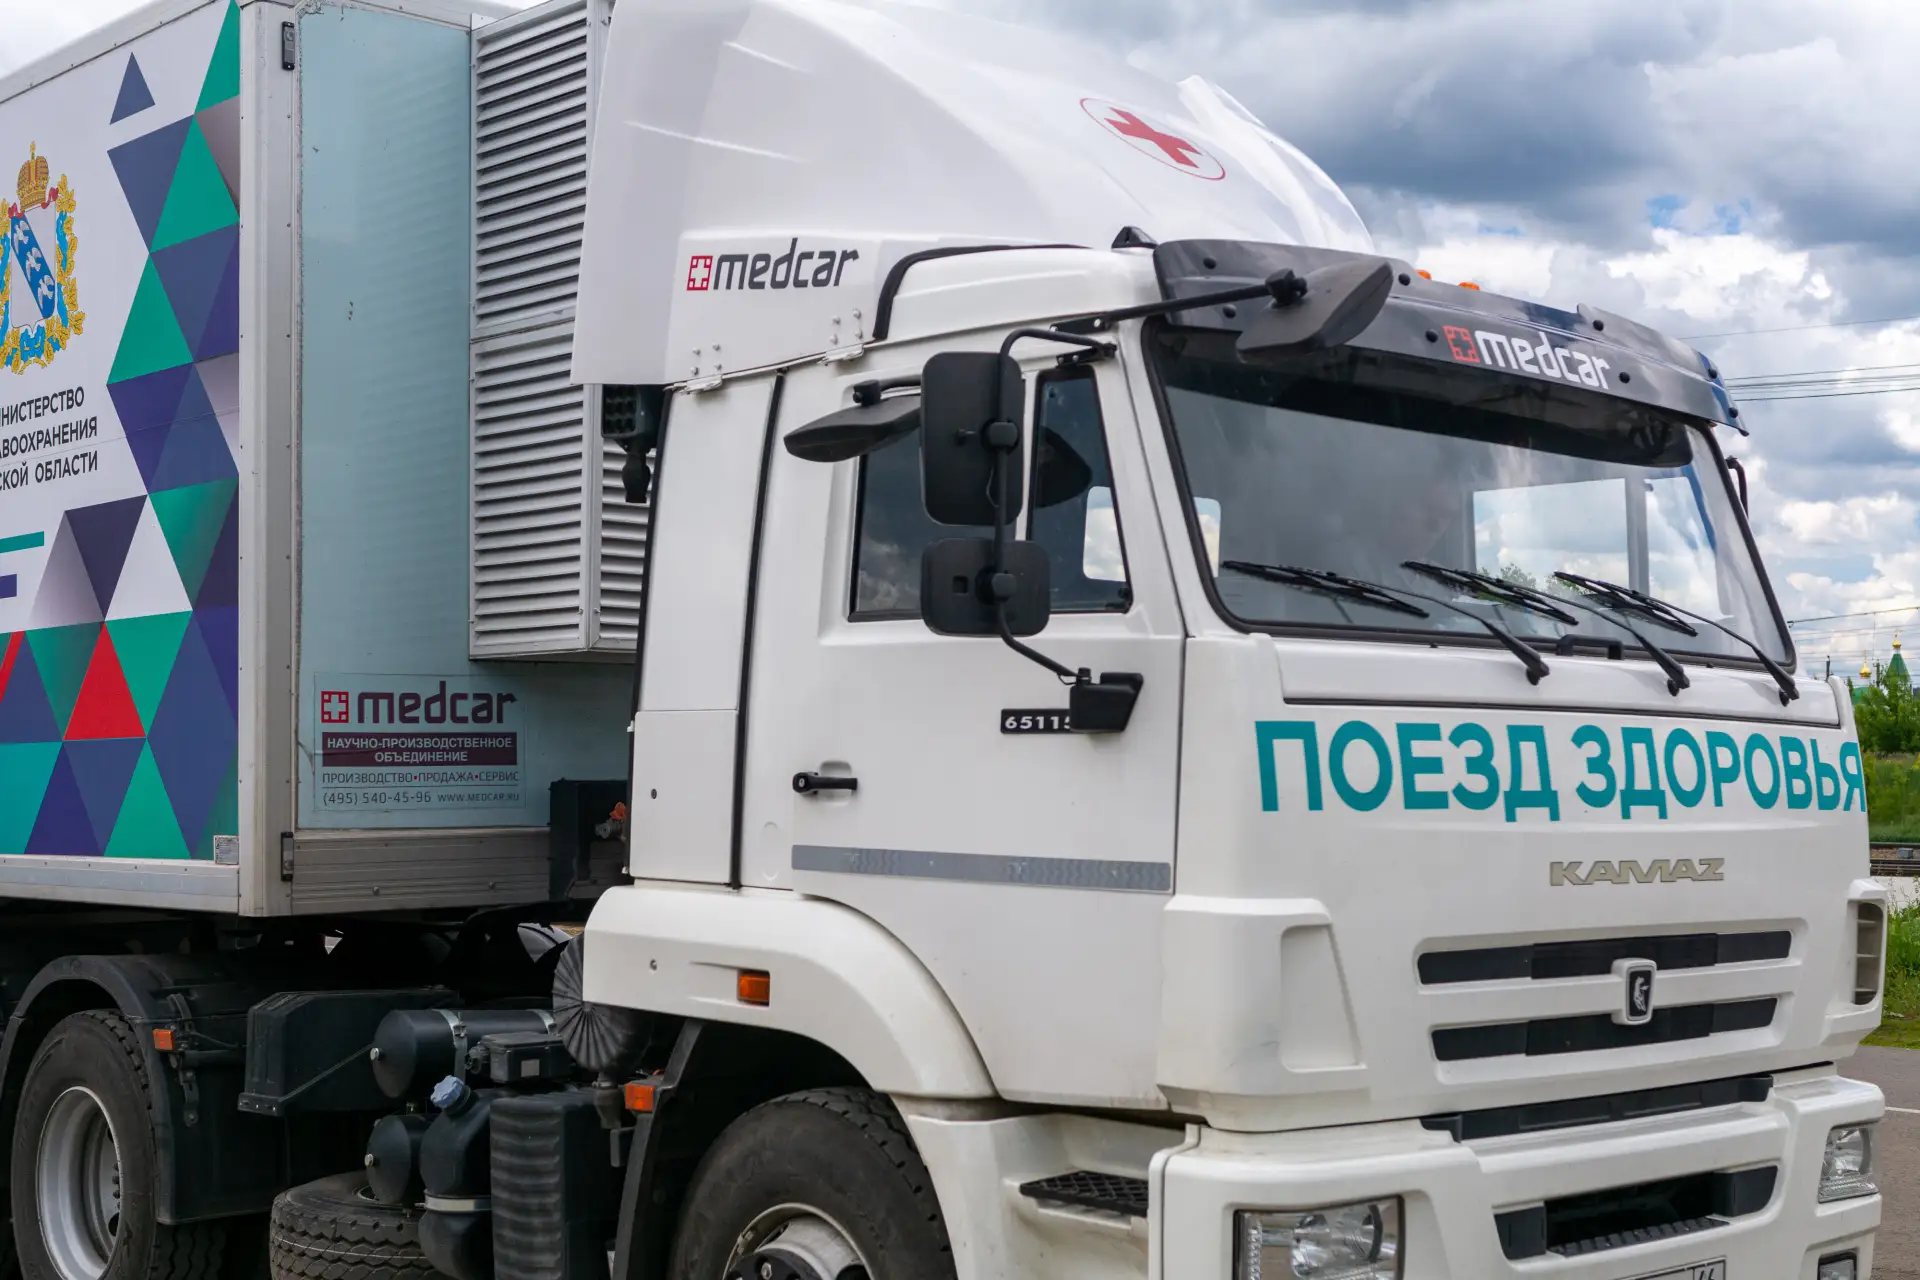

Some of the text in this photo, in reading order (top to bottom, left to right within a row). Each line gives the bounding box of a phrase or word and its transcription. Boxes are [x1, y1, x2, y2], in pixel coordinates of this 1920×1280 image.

[713, 237, 860, 290] medcar
[1474, 330, 1612, 389] medcar
[0, 386, 84, 427] НИСТЕРСТВО
[0, 416, 97, 458] ВООХРАНЕНИЯ
[35, 450, 98, 483] ОБЛАСТИ
[357, 680, 518, 724] medcar
[327, 737, 513, 749] НАУЧНО-ПРОИЗВОДСТВЕННОЕ
[374, 751, 468, 763] ОБЪЕДИНЕНИЕ
[1255, 720, 1866, 822] ПОЕЗД ЗДОРОВЬЯ
[323, 792, 358, 806] (495)
[362, 791, 432, 805] 540-45-96
[1550, 858, 1725, 887] KAMAZ
